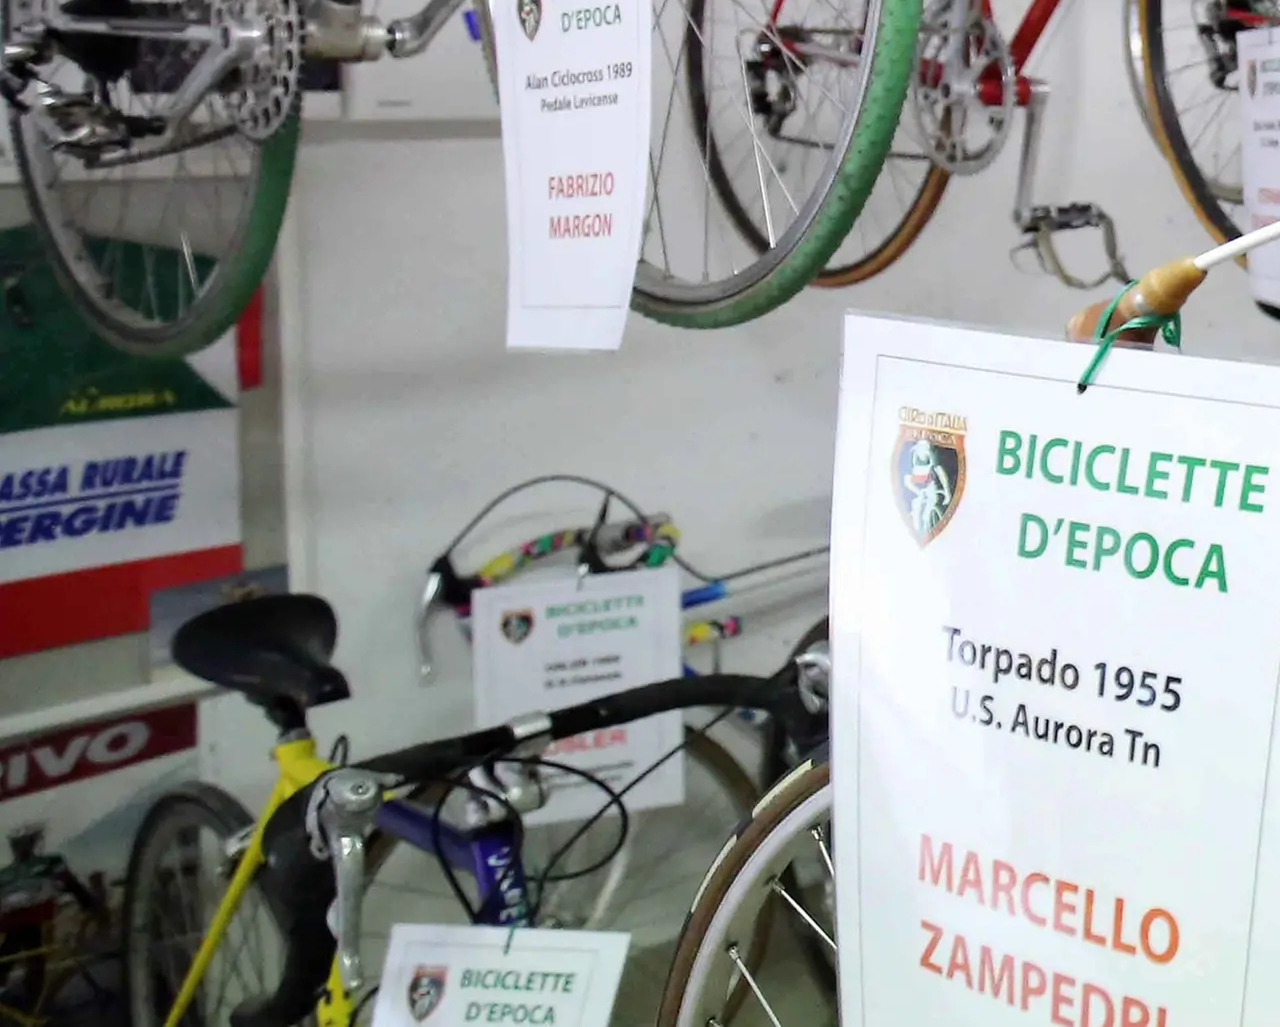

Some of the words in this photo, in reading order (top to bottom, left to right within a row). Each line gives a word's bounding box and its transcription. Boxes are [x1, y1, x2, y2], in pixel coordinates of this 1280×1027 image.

[561, 4, 622, 33] D'EPOCA
[525, 74, 549, 90] Alan
[551, 68, 604, 88] Ciclocross
[607, 62, 633, 80] 1989
[548, 172, 614, 200] FABRIZIO
[549, 213, 612, 240] MARGON
[0, 466, 69, 502] ASSA
[80, 449, 187, 490] RURALE
[996, 430, 1269, 513] BICICLETTE
[0, 493, 182, 549] ERGINE
[1017, 512, 1228, 593] D'EPOCA
[942, 625, 1080, 691] Torpado
[1094, 662, 1182, 712] 1955
[952, 686, 1002, 729] U.S.
[1010, 703, 1114, 757] Aurora
[1124, 728, 1161, 767] Tn
[0, 721, 150, 790] IVO
[918, 833, 1180, 965] MARCELLO
[461, 968, 576, 992] BICICLETTE
[465, 1002, 555, 1024] D'EPOCA
